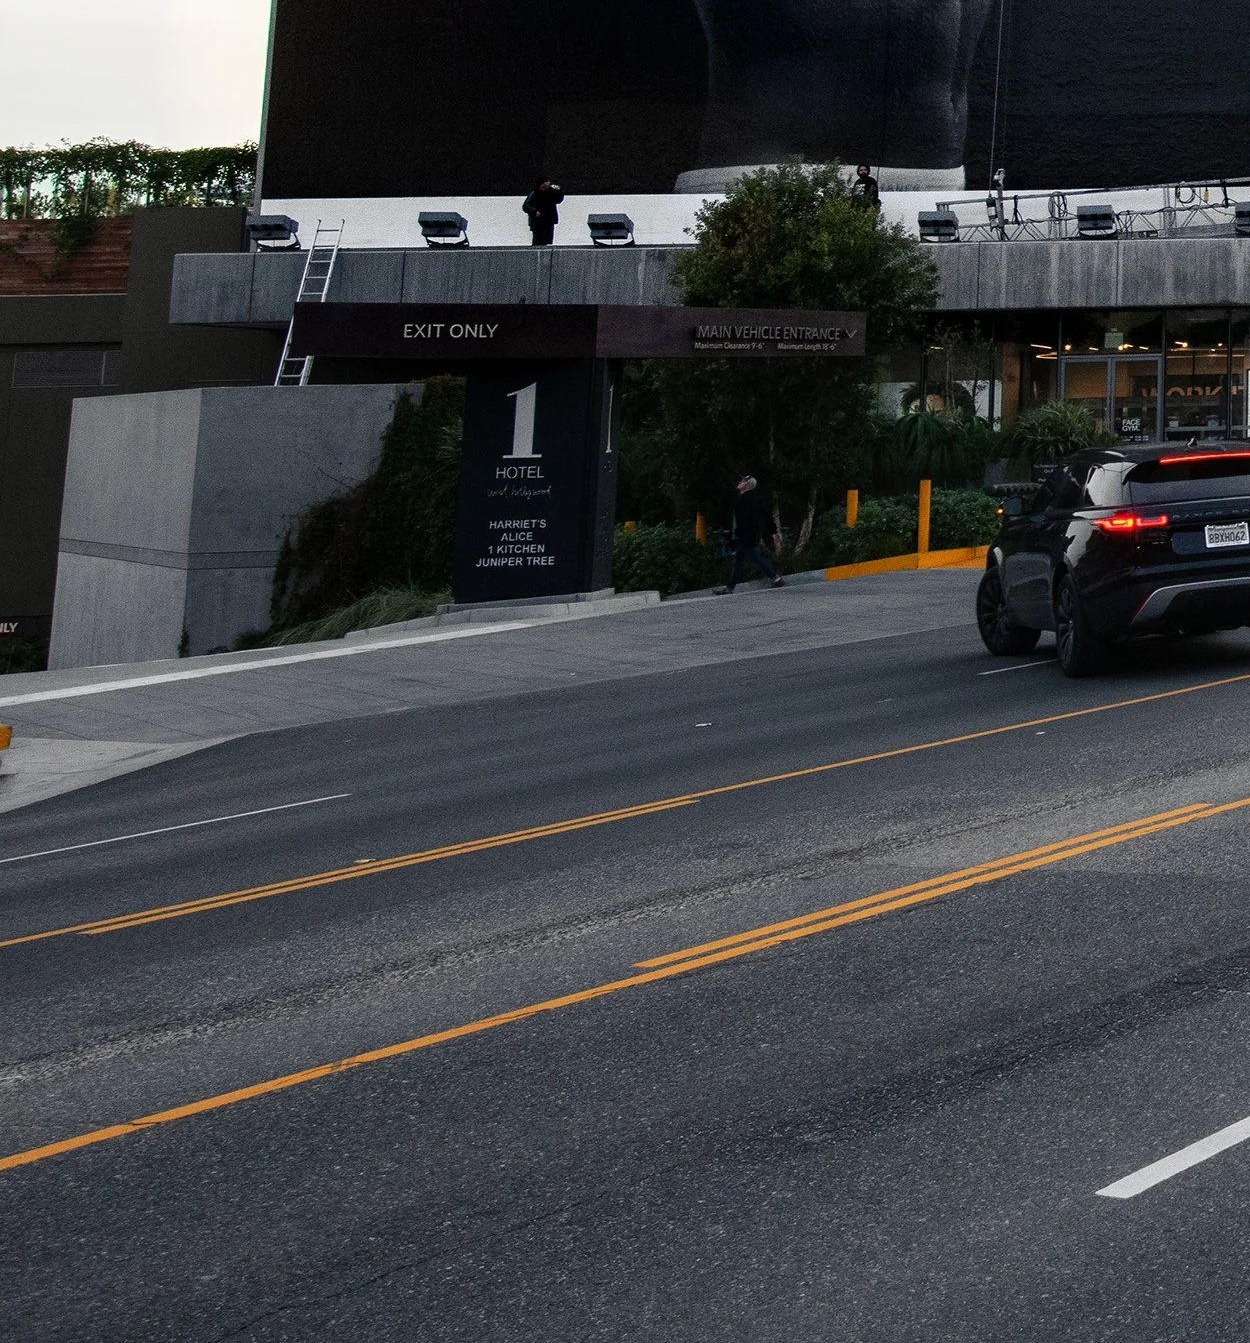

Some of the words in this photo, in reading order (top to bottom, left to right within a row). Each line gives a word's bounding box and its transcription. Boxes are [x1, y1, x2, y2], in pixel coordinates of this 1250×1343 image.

[403, 323, 445, 338] EXIT
[449, 323, 499, 339] ONLY
[697, 325, 732, 339] MAIN
[733, 325, 781, 340] VEHICLE
[783, 326, 841, 341] ENTRANCE
[694, 341, 723, 350] Maximum
[724, 341, 750, 350] Clearance
[777, 342, 803, 350] Maximum
[804, 343, 822, 351] Length
[502, 381, 542, 459] 1
[1122, 418, 1141, 426] FACE
[495, 465, 545, 480] HOTEL
[489, 519, 547, 530] HARRIET'S
[500, 531, 533, 542] ALICE
[488, 545, 493, 555] 1
[496, 544, 545, 554] KITCHEN
[475, 557, 524, 567] JUNIPER
[527, 556, 556, 566] TREE
